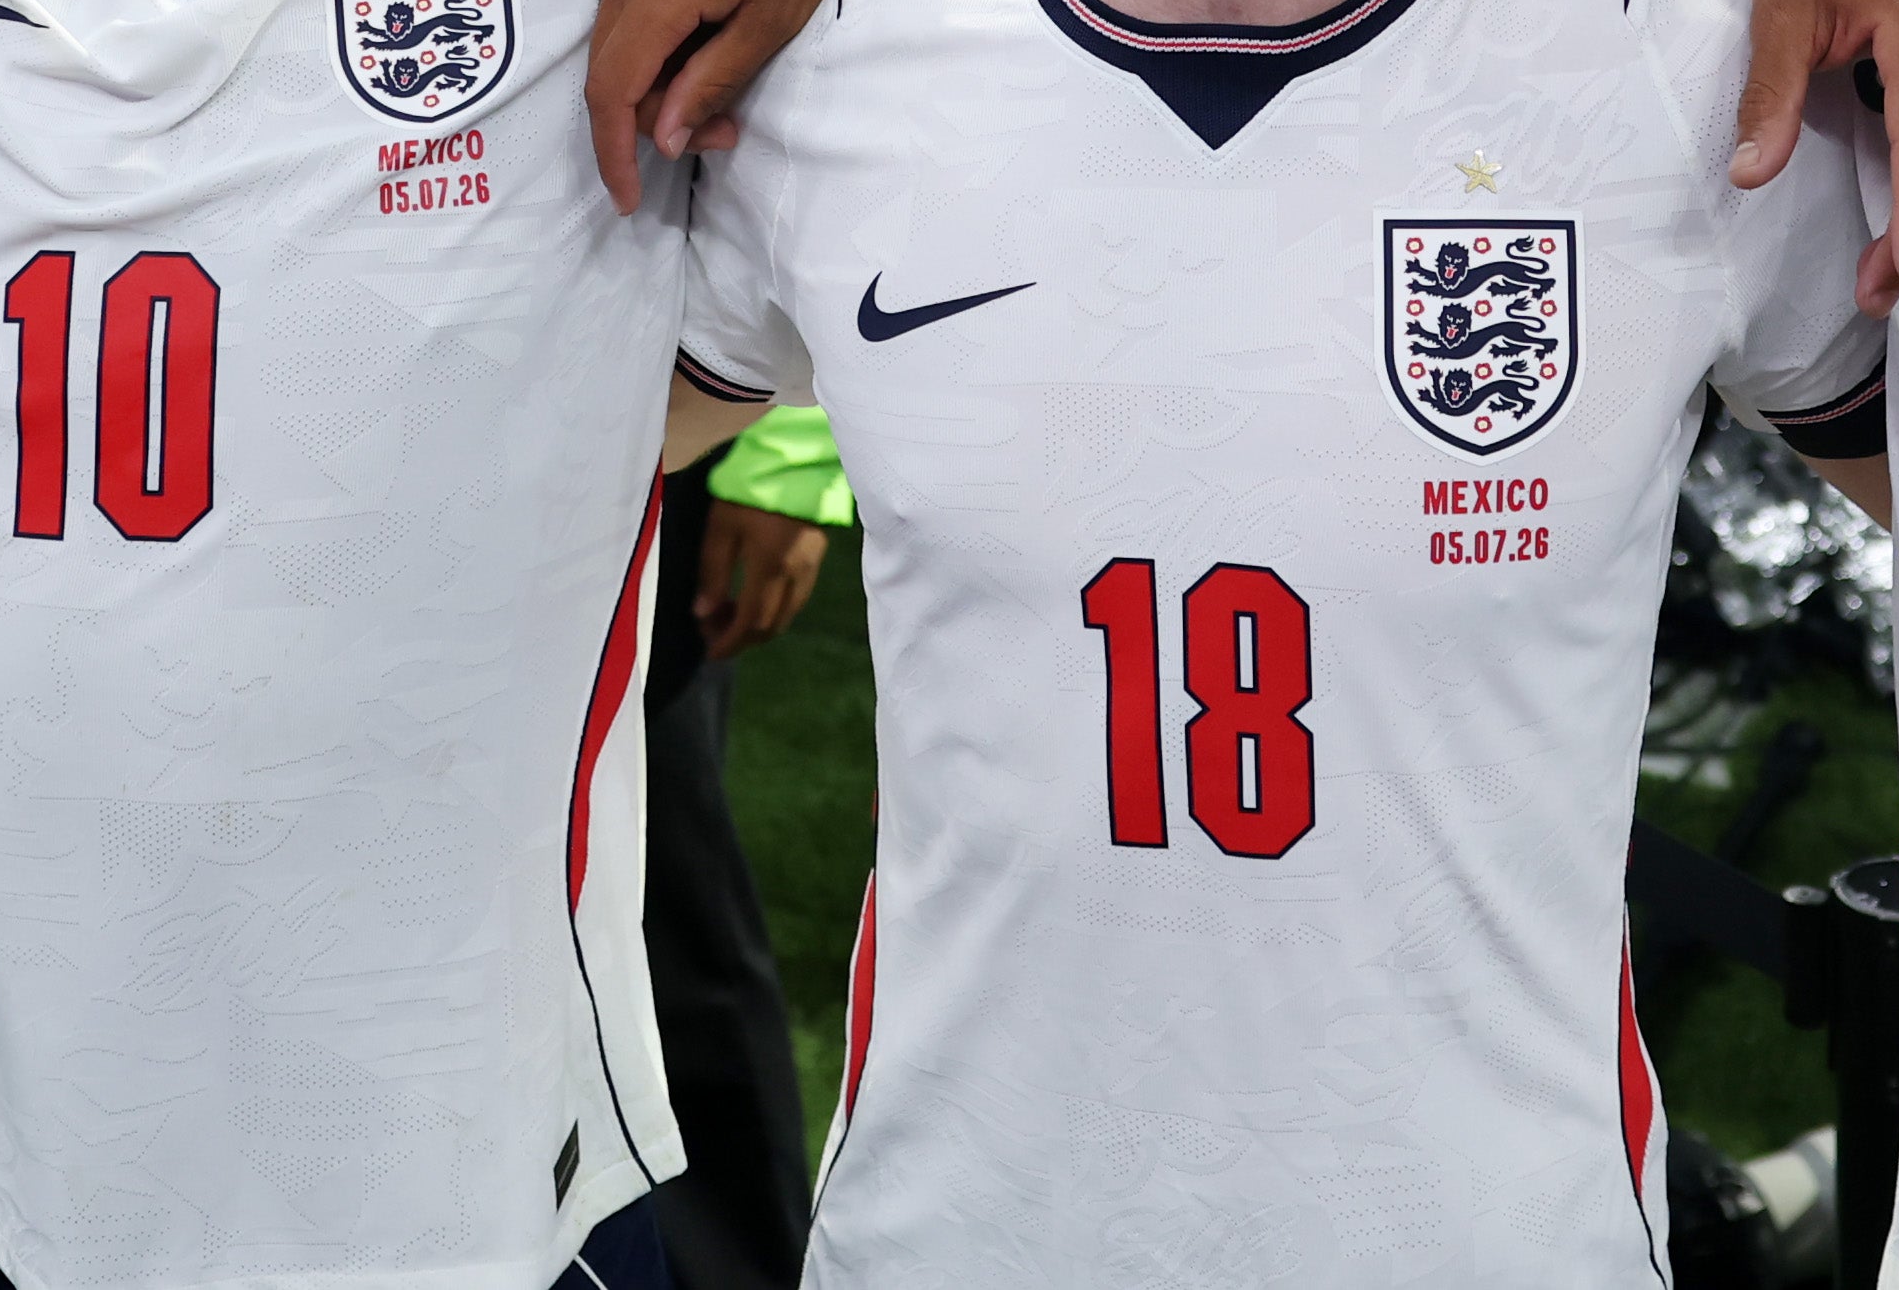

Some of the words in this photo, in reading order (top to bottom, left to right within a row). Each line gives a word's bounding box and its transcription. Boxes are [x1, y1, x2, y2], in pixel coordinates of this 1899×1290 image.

[377, 130, 485, 172] MEXICO
[378, 177, 491, 215] 05.07.26
[3, 249, 221, 542] 10
[1423, 478, 1549, 516] MEXICO
[1429, 527, 1549, 565] 05.07.26
[1080, 557, 1316, 860] 18
